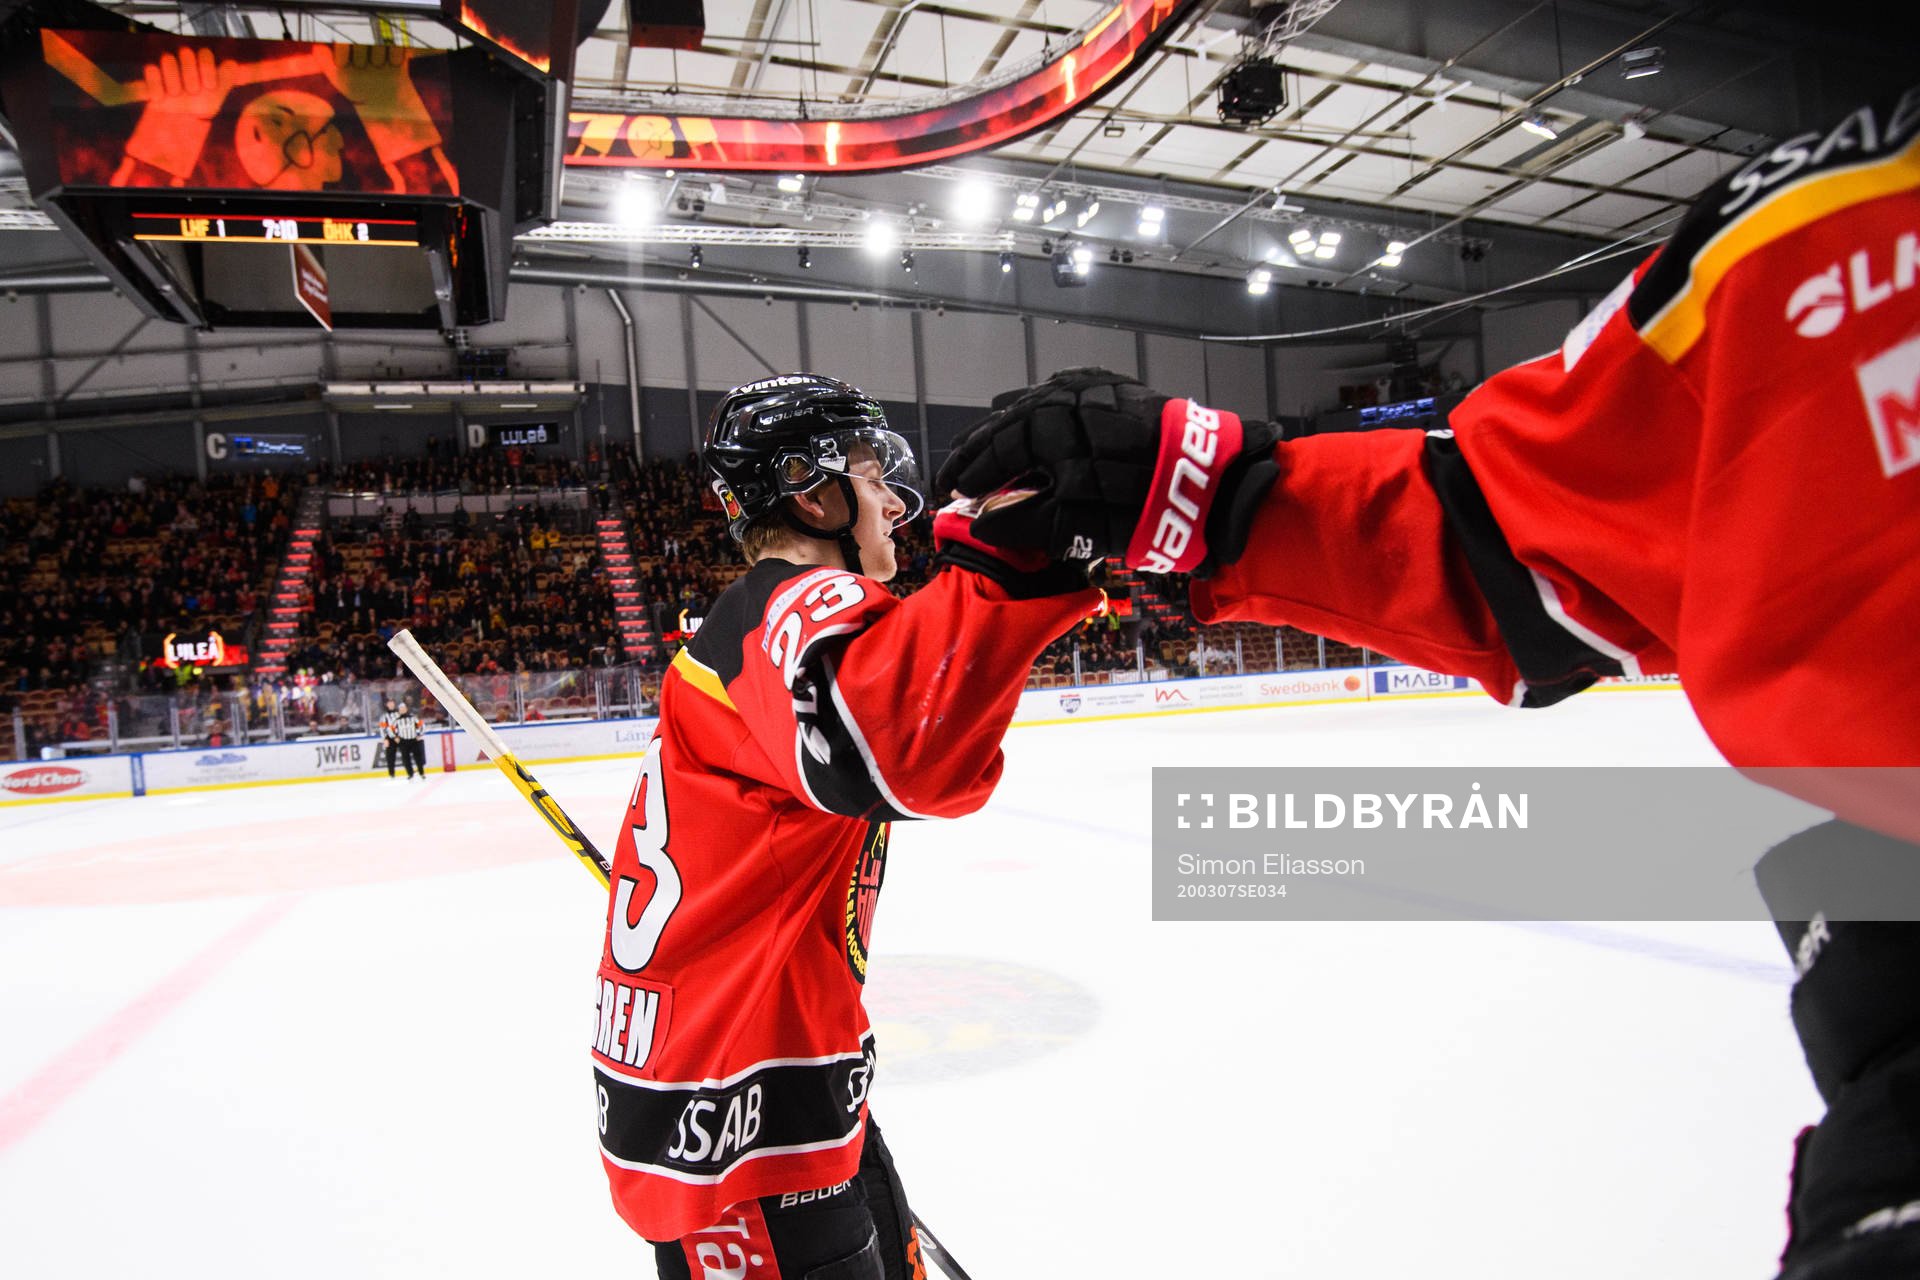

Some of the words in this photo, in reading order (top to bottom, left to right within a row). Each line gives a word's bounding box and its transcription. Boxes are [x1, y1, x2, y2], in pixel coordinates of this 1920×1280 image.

[180, 218, 210, 237] LHF
[216, 219, 226, 238] 1
[262, 219, 299, 240] 7:10
[322, 218, 354, 240] ÖHK
[356, 223, 369, 241] 2
[206, 433, 227, 460] C
[467, 424, 486, 448] D
[1137, 398, 1220, 575] BAUER
[769, 574, 866, 691] 23
[1259, 679, 1340, 696] Swedbank
[1393, 672, 1449, 689] MABI
[315, 744, 361, 768] JWAB
[668, 1083, 762, 1162] SSAB
